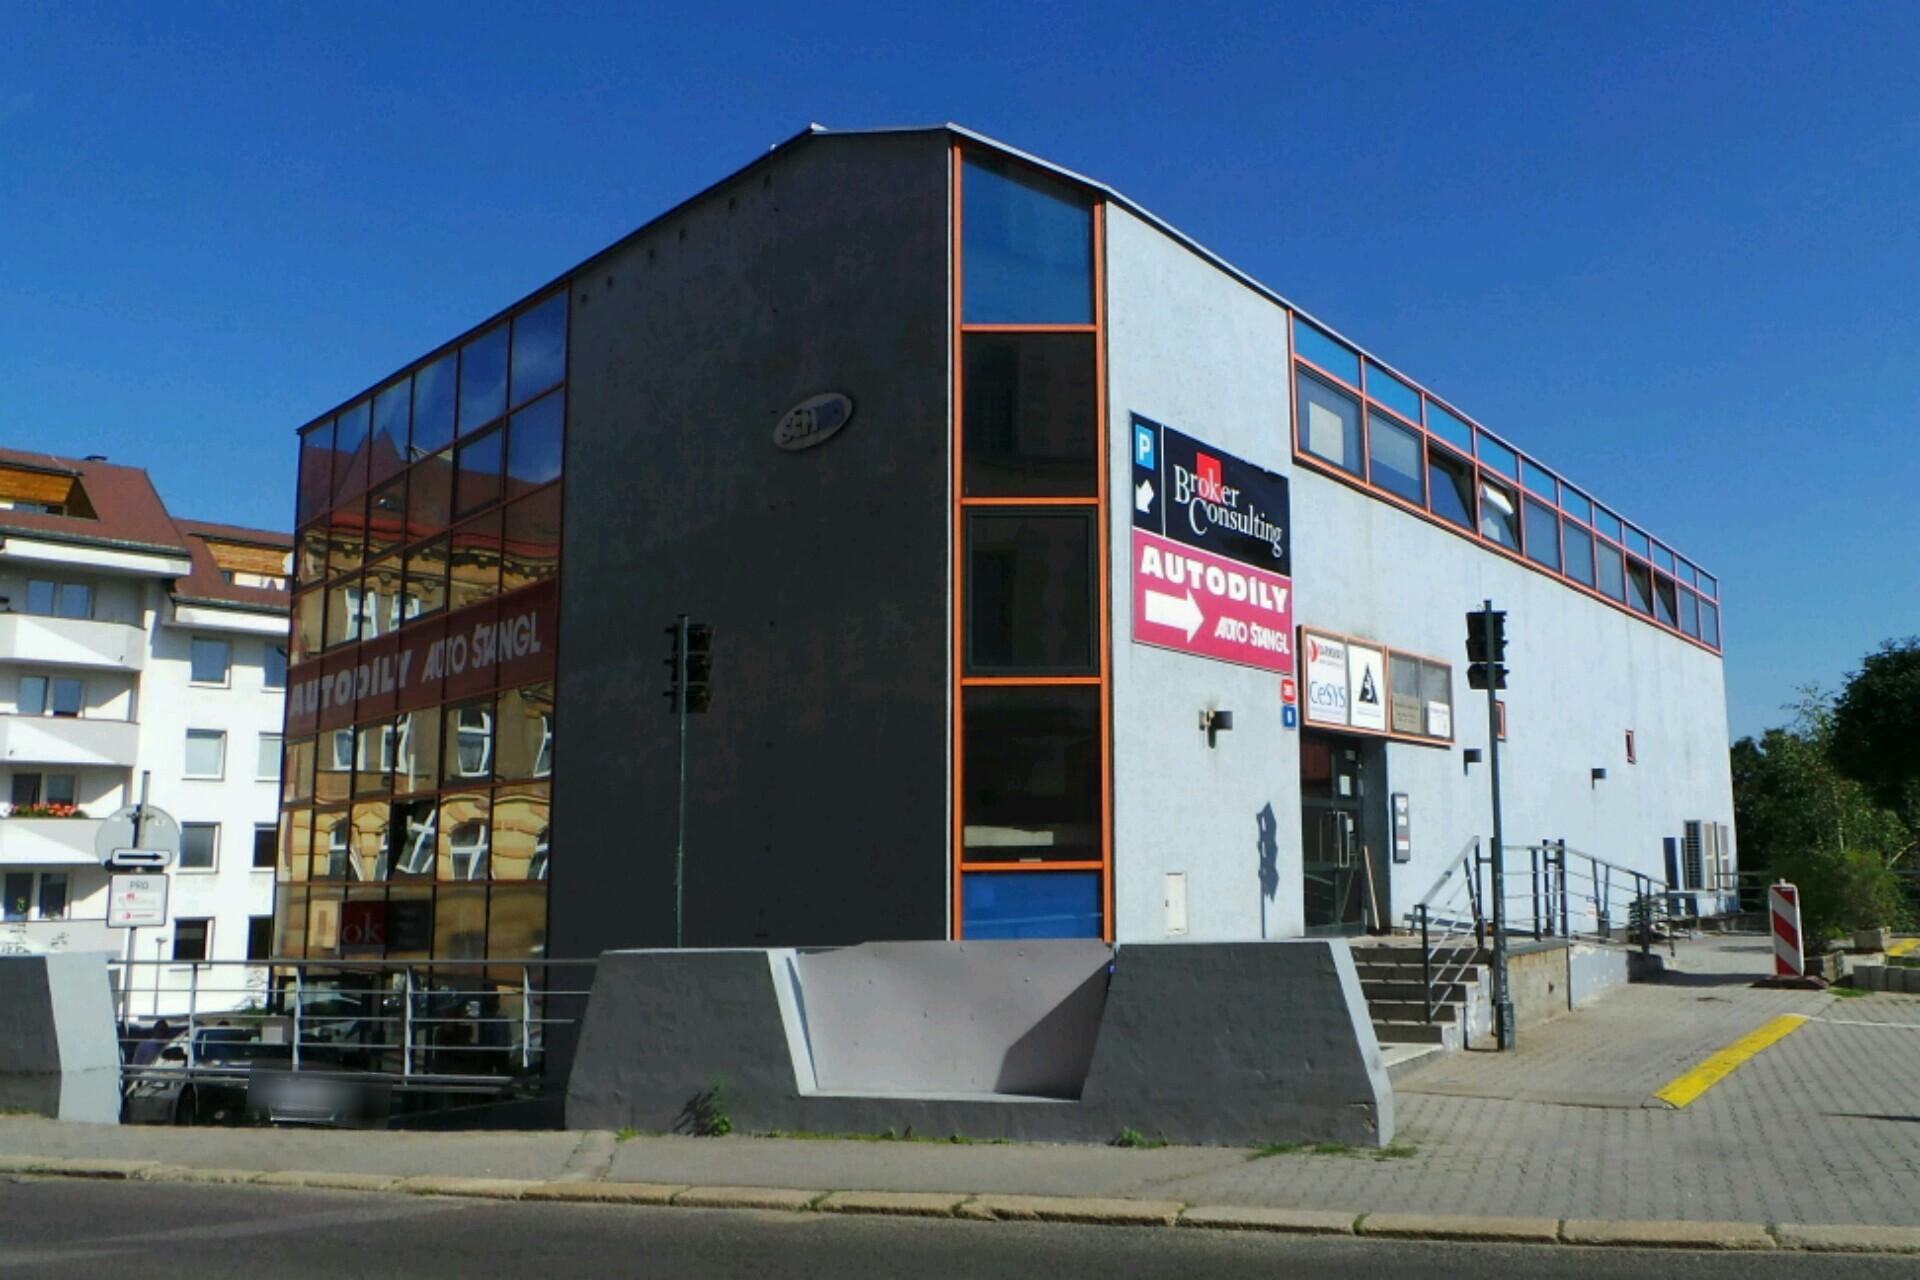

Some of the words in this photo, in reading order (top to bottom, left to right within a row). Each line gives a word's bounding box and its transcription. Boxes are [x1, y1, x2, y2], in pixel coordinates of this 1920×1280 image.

[1139, 434, 1150, 461] P
[1173, 464, 1240, 507] Broker
[1188, 497, 1283, 558] Consulting
[1214, 616, 1248, 645] AUTO
[421, 634, 467, 683] AUTO
